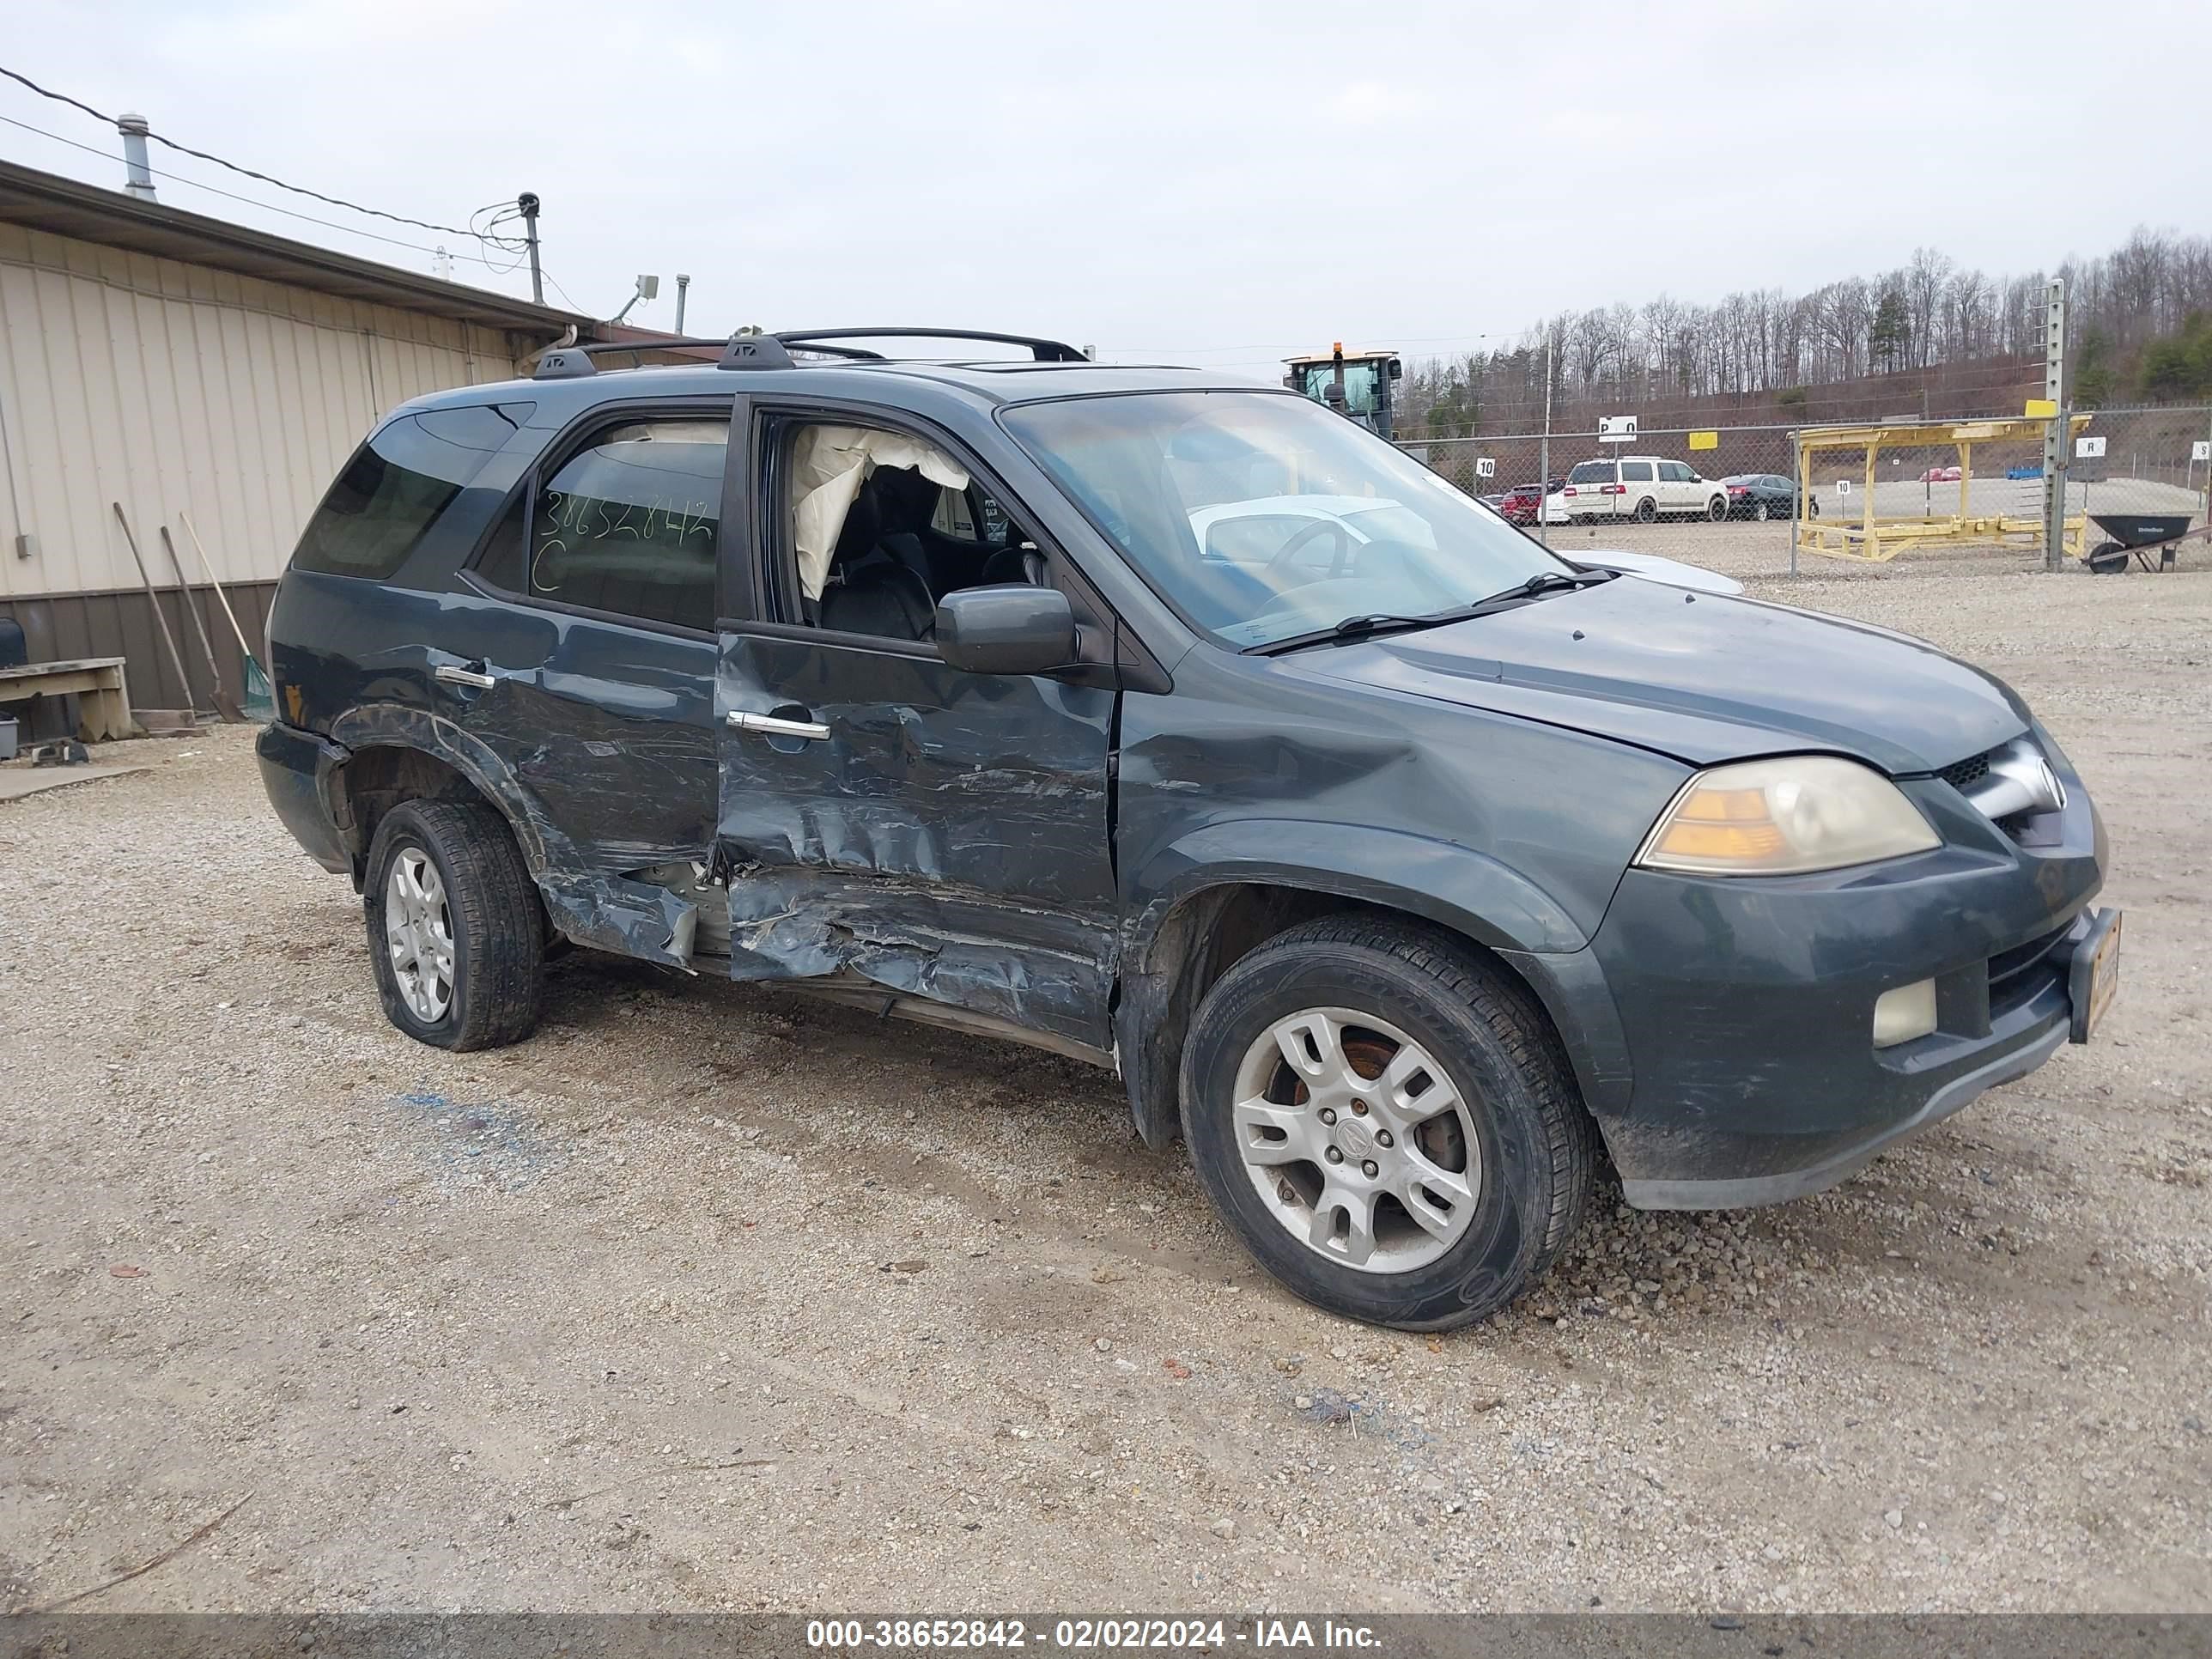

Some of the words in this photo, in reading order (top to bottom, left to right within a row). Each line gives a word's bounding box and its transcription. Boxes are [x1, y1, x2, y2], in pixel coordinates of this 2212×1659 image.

[2087, 442, 2094, 453] R
[2201, 446, 2207, 455] S
[1480, 460, 1493, 474] 10
[1839, 483, 1848, 493] 10
[540, 491, 713, 546] 38652842
